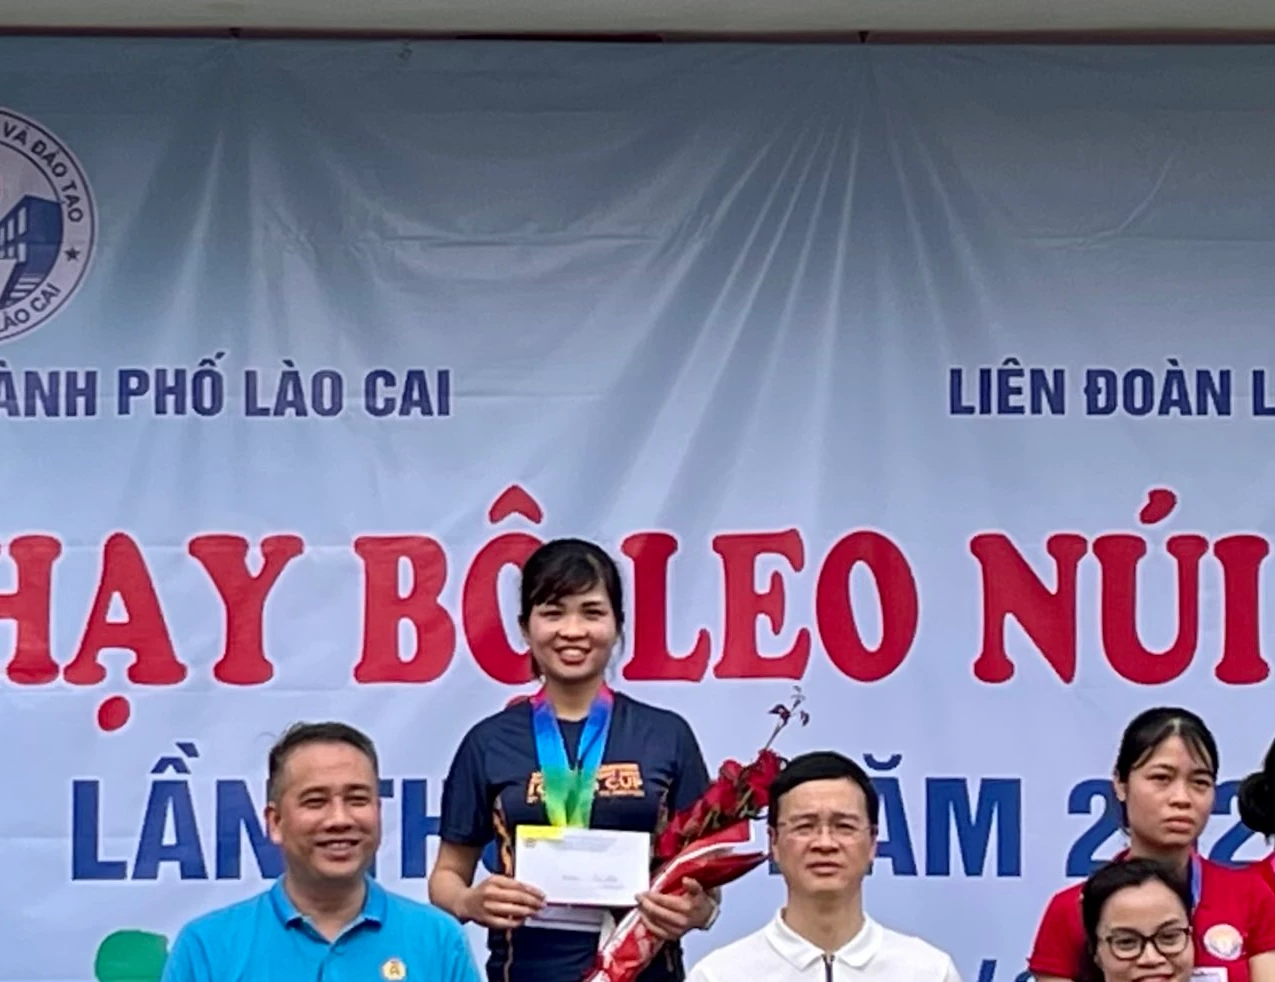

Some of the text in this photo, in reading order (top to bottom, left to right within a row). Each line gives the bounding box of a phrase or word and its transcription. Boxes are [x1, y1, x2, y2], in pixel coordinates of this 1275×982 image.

[3, 122, 28, 146] VÀ
[30, 281, 62, 313] CAI
[118, 351, 226, 416] PHỐ
[245, 359, 344, 418] LÀO
[364, 368, 451, 417] CAI
[949, 357, 1065, 416] LIÊN
[1083, 358, 1232, 417] ĐOÀN
[621, 528, 918, 683] LEO
[970, 489, 1269, 684] NÚI
